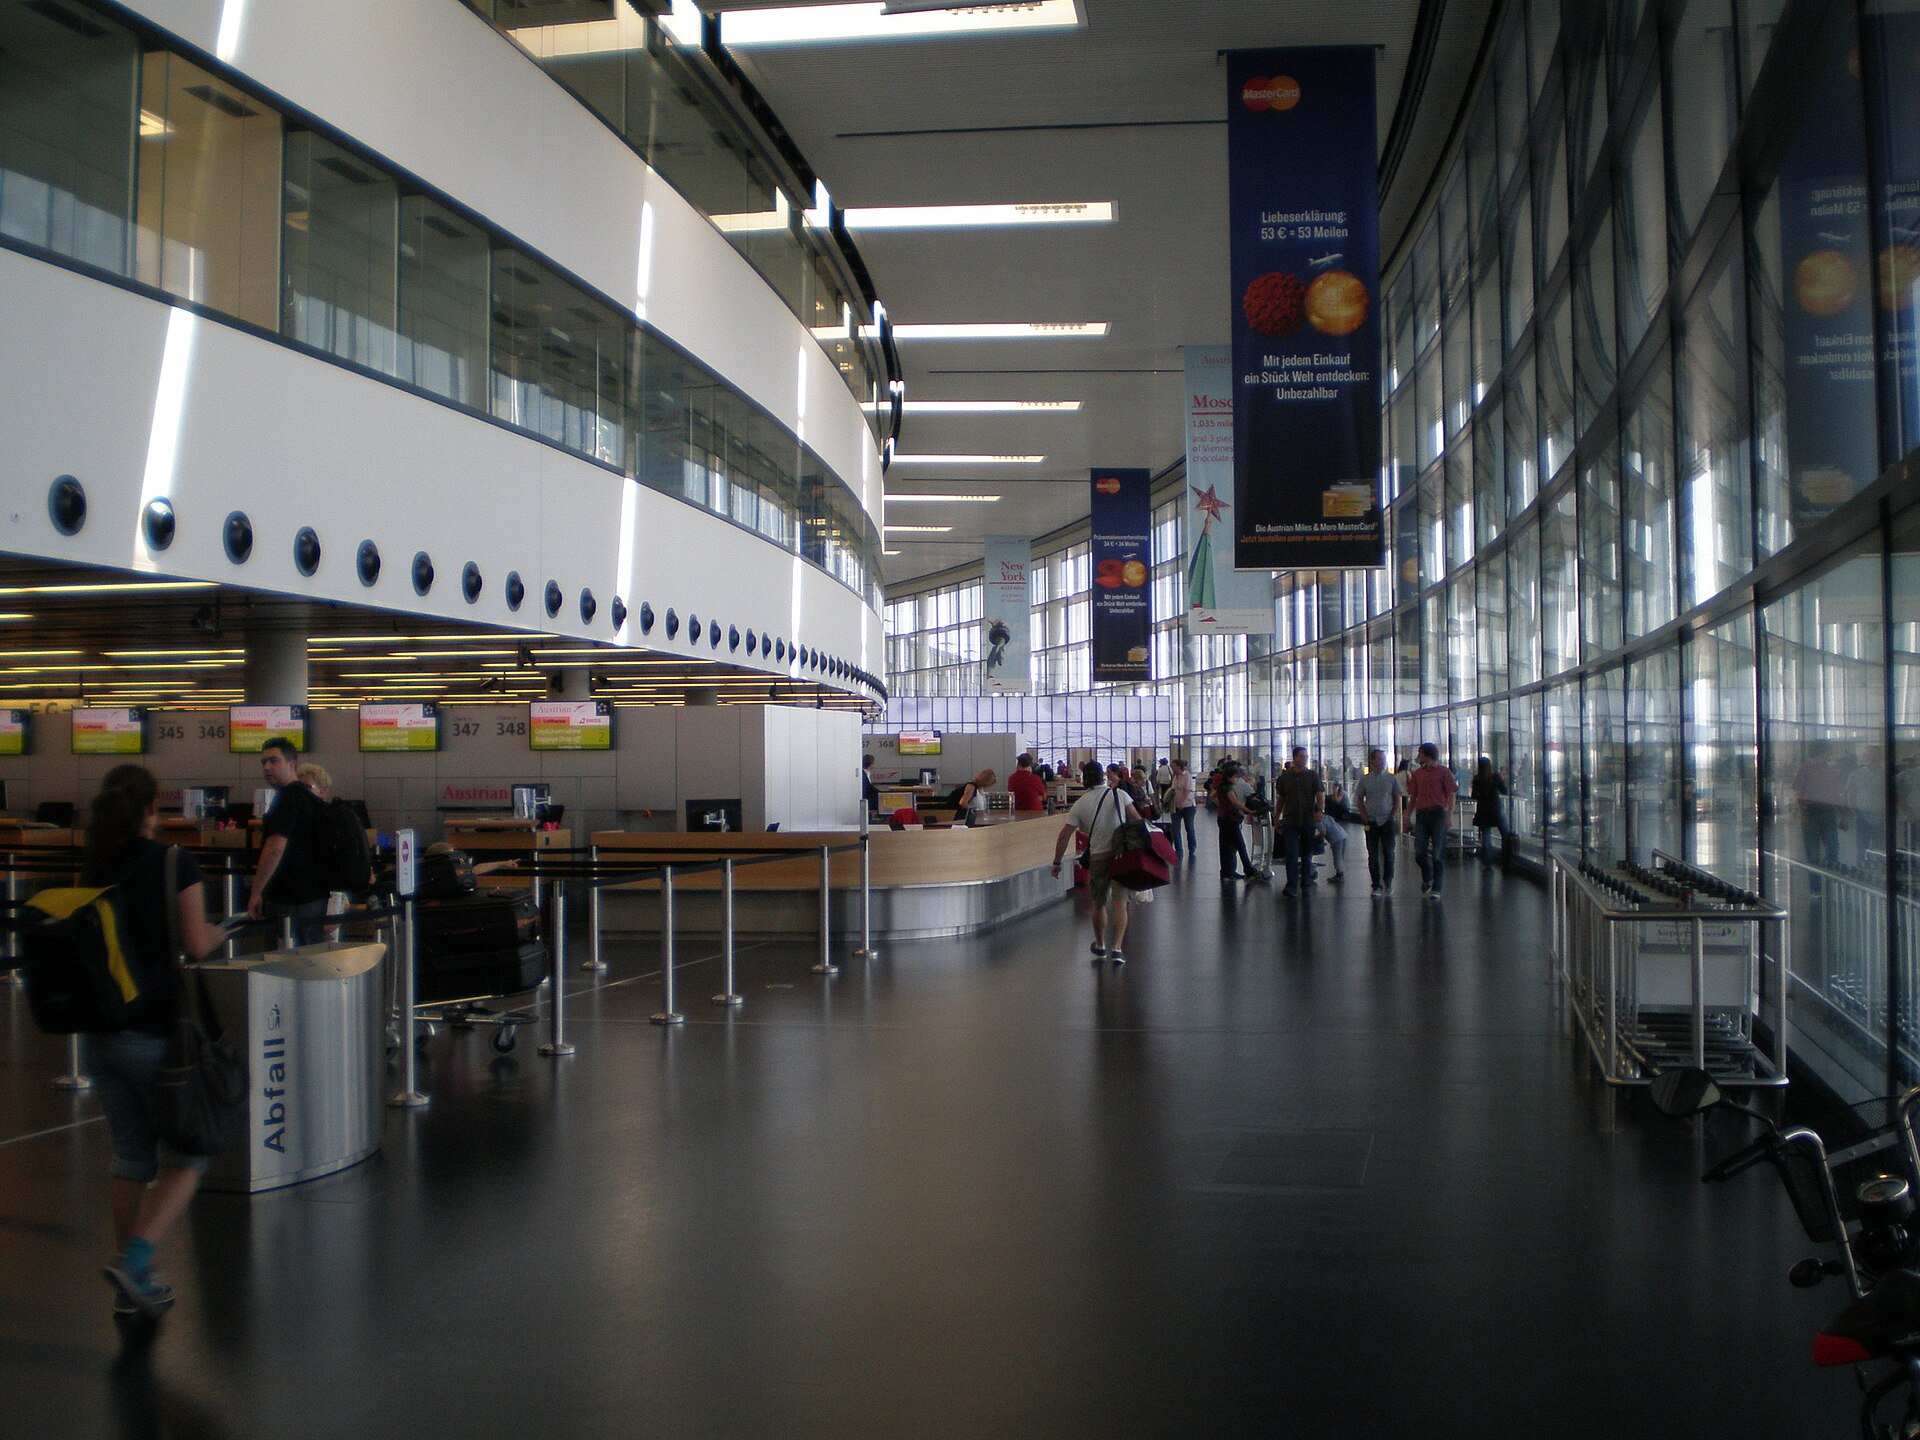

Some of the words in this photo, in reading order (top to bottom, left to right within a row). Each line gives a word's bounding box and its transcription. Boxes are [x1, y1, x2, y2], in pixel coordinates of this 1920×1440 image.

[1243, 87, 1300, 100] MasterCard
[1262, 210, 1347, 224] Liebeserklärung:
[1261, 227, 1275, 240] 53
[1278, 227, 1287, 239] €
[1298, 226, 1311, 239] 53
[1314, 225, 1348, 238] Meilen
[1263, 355, 1279, 367] Mit
[1281, 354, 1311, 368] jedem
[1313, 353, 1351, 366] Einkauf
[1244, 373, 1259, 384] ein
[1261, 371, 1290, 383] Stück
[1292, 370, 1314, 382] Welt
[1316, 370, 1370, 382] entdecken:
[1276, 387, 1339, 400] Unbezahlbar
[1255, 524, 1266, 533] Die
[1267, 524, 1294, 533] Austrian
[1294, 523, 1312, 532] Miles
[1313, 523, 1319, 531] &
[1320, 522, 1337, 531] More
[1001, 561, 1024, 571] New
[1001, 572, 1026, 581] York
[158, 726, 184, 739] 345
[199, 726, 225, 739] 346
[452, 723, 480, 736] 347
[497, 722, 526, 736] 348
[878, 740, 894, 748] 368
[442, 784, 509, 800] Austrian
[263, 1036, 286, 1154] Abfall
